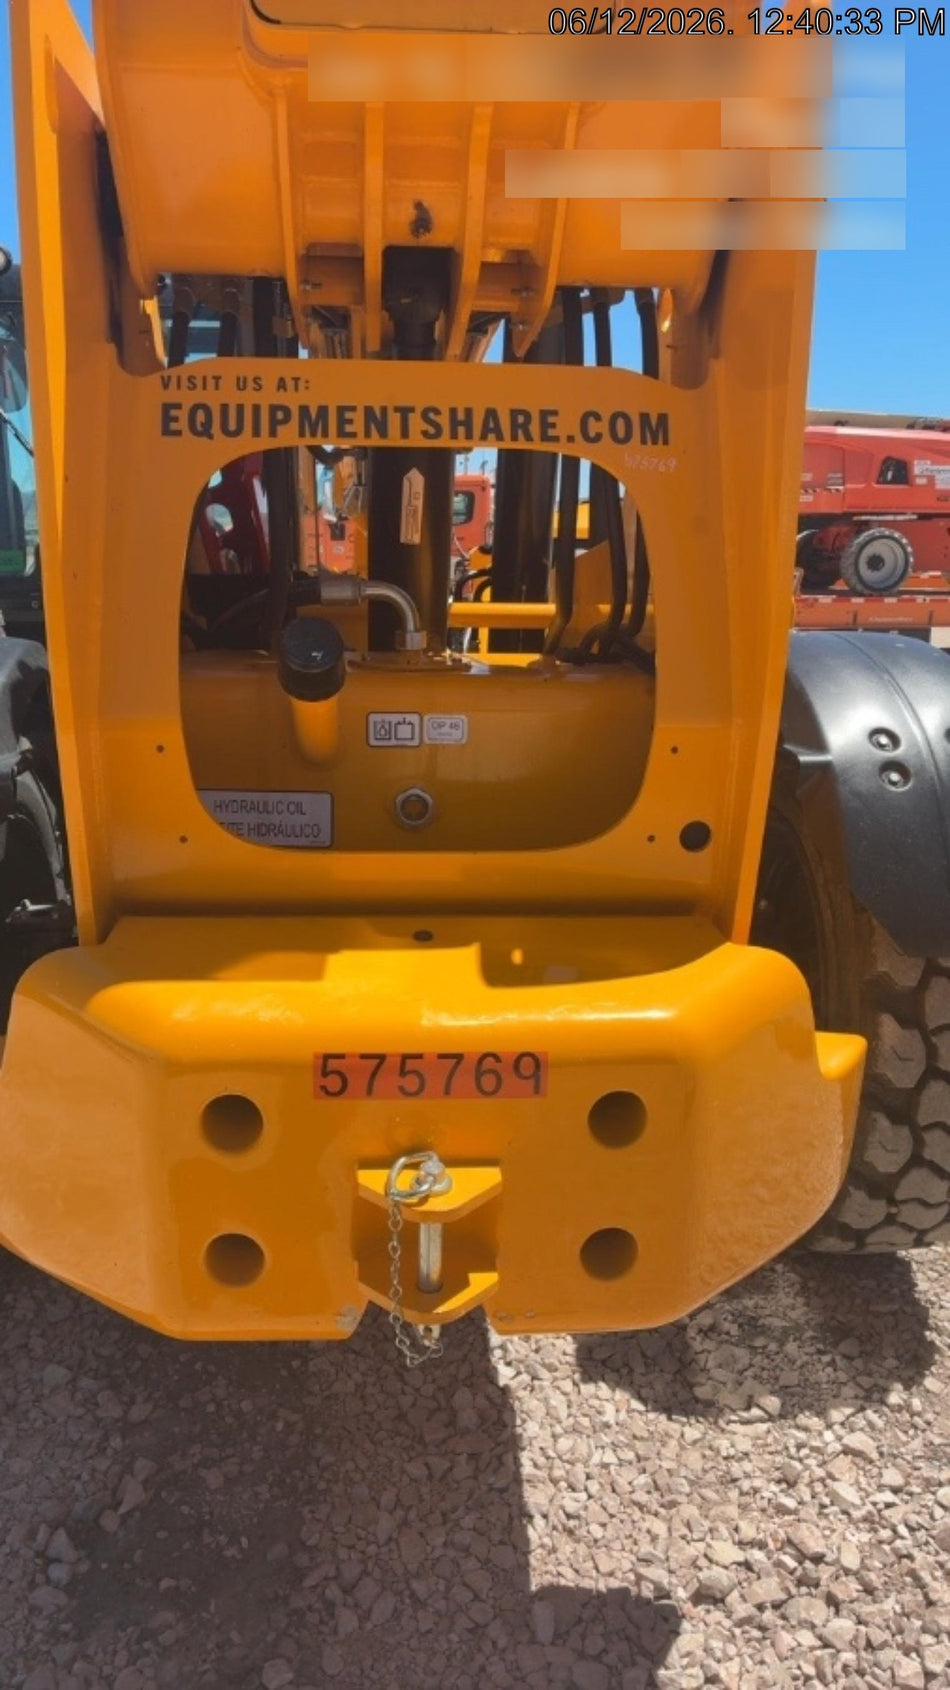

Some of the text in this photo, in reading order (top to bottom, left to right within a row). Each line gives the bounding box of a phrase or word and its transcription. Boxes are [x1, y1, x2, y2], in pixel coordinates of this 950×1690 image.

[160, 375, 311, 393] VISIT US AT:
[160, 402, 670, 446] EQUIPMENTSHARE.COM
[213, 799, 307, 816] HYDRAULIC OIL
[246, 820, 322, 839] HIDRÁULICO
[319, 1052, 543, 1097] 575769
